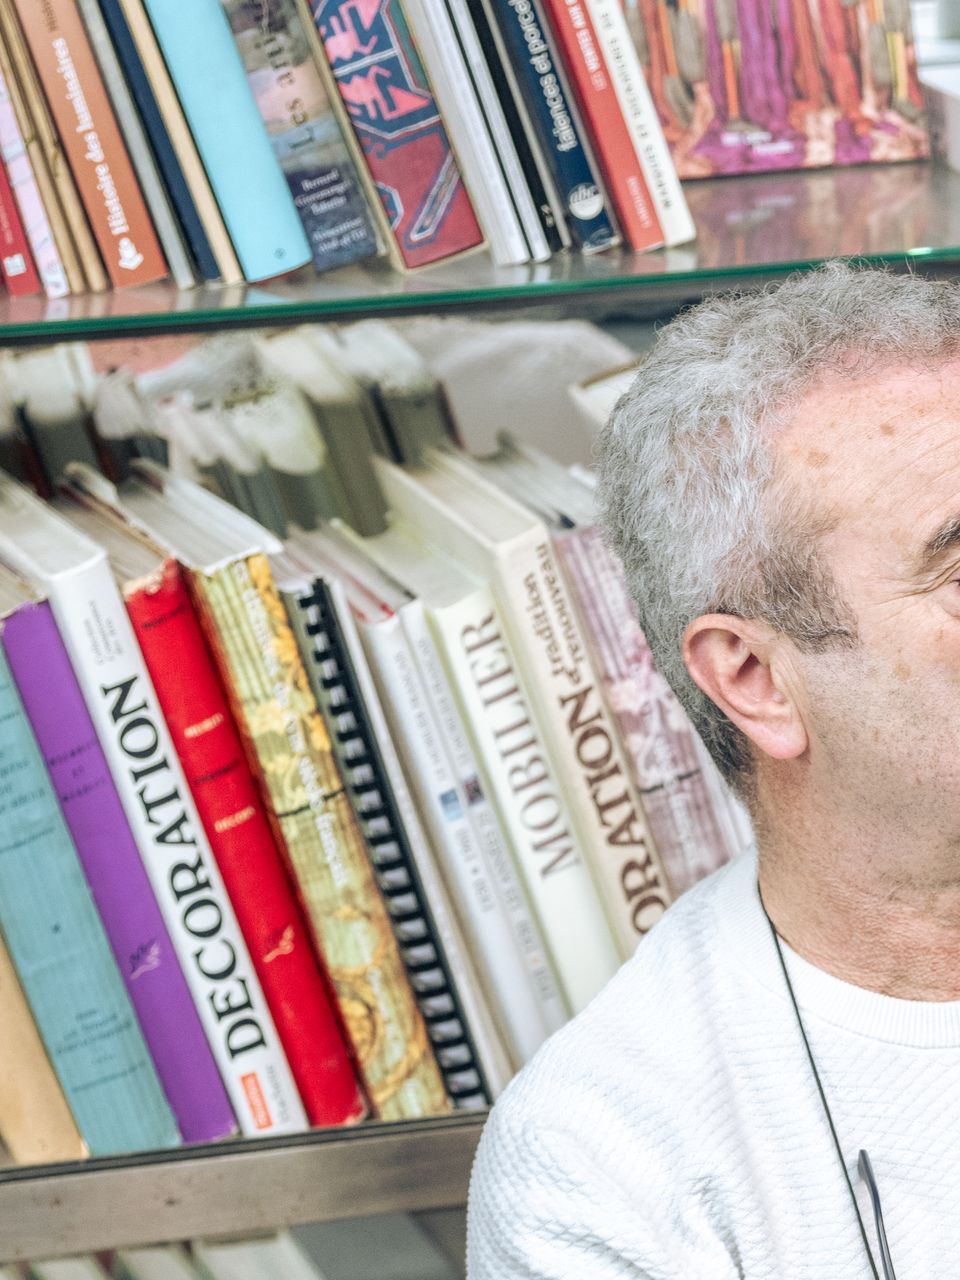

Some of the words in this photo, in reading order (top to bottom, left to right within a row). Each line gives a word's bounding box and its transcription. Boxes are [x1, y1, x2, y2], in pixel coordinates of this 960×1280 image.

[52, 37, 95, 133] luminaires
[530, 52, 553, 74] et
[576, 28, 599, 74] VENTES
[84, 131, 105, 162] des
[95, 163, 130, 236] Histoire
[523, 570, 565, 678] tradition
[535, 541, 584, 666] renouveau
[460, 611, 582, 881] MOBILIER
[100, 674, 268, 1060] DECORATION
